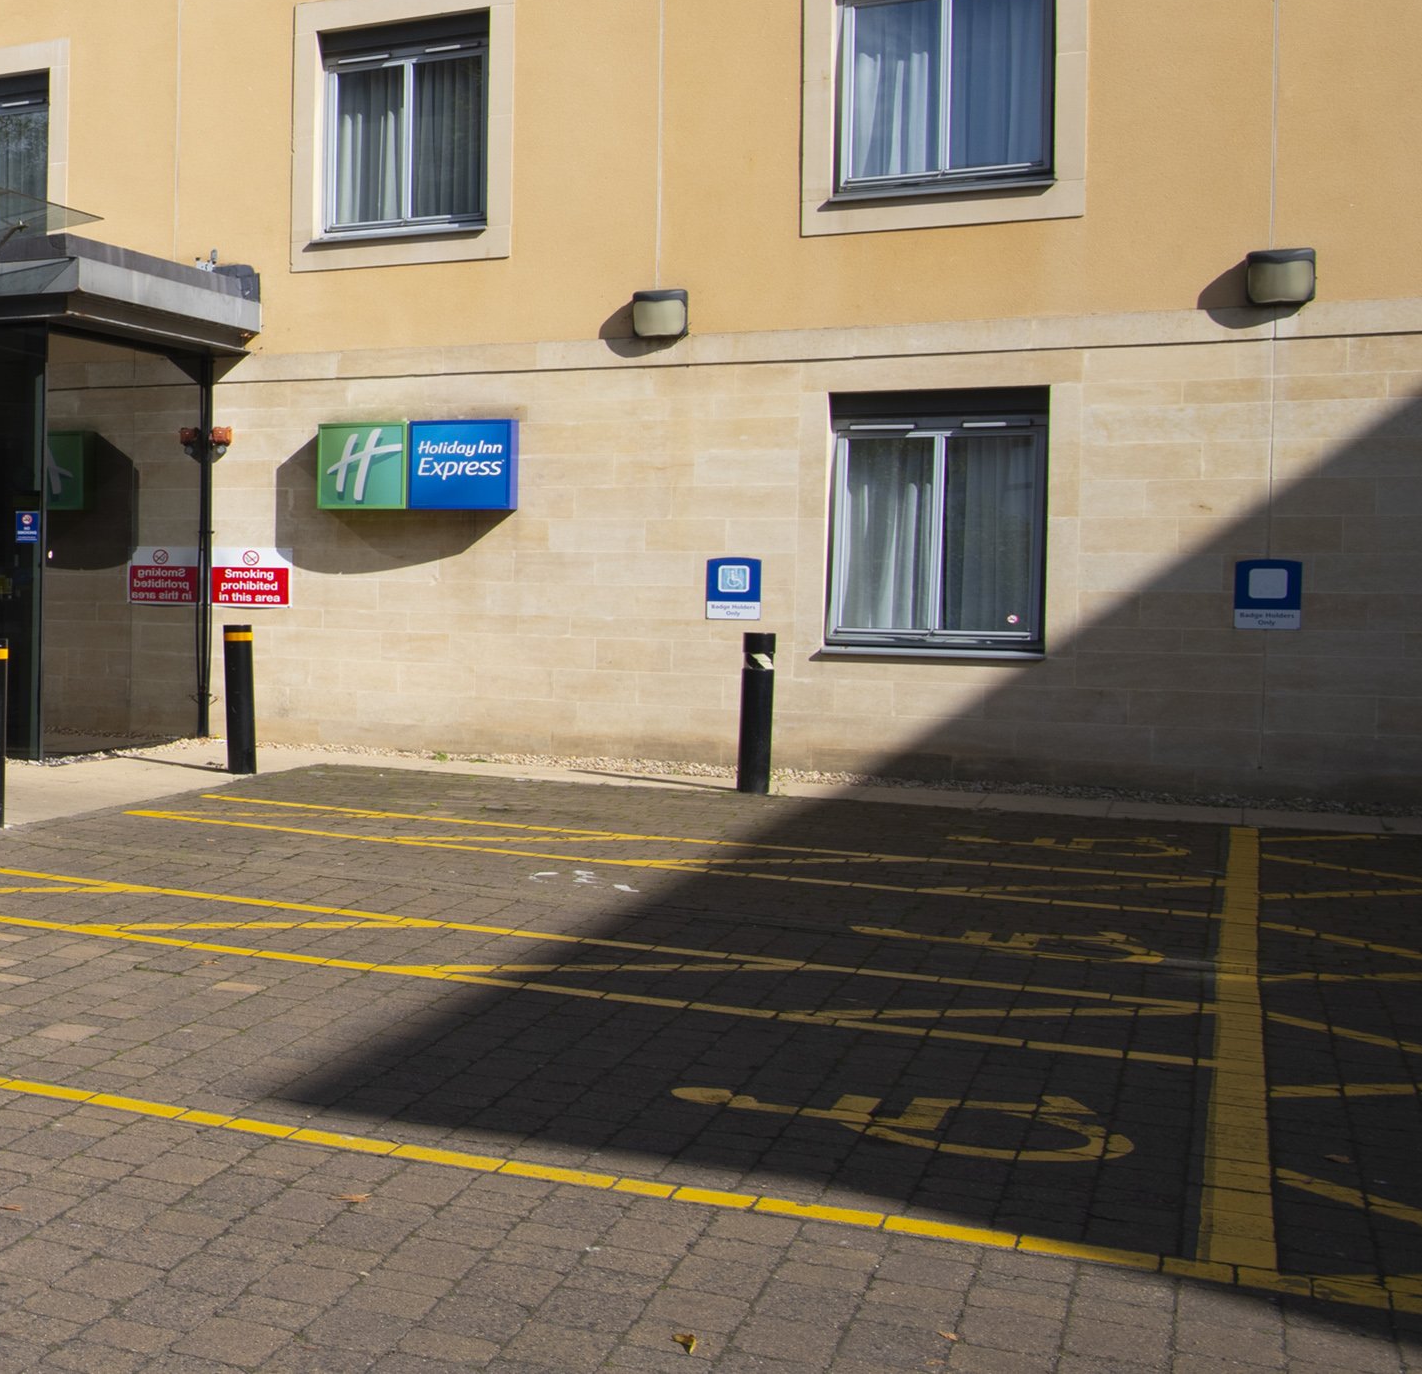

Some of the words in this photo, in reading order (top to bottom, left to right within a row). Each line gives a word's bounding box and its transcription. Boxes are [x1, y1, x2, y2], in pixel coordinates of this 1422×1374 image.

[417, 439, 476, 457] Holiday
[477, 439, 503, 454] Inn
[417, 457, 503, 481] Express
[224, 568, 274, 581] Smoking
[220, 581, 278, 592] prohibited
[218, 592, 229, 601] in
[231, 592, 252, 602] this
[255, 594, 280, 603] area
